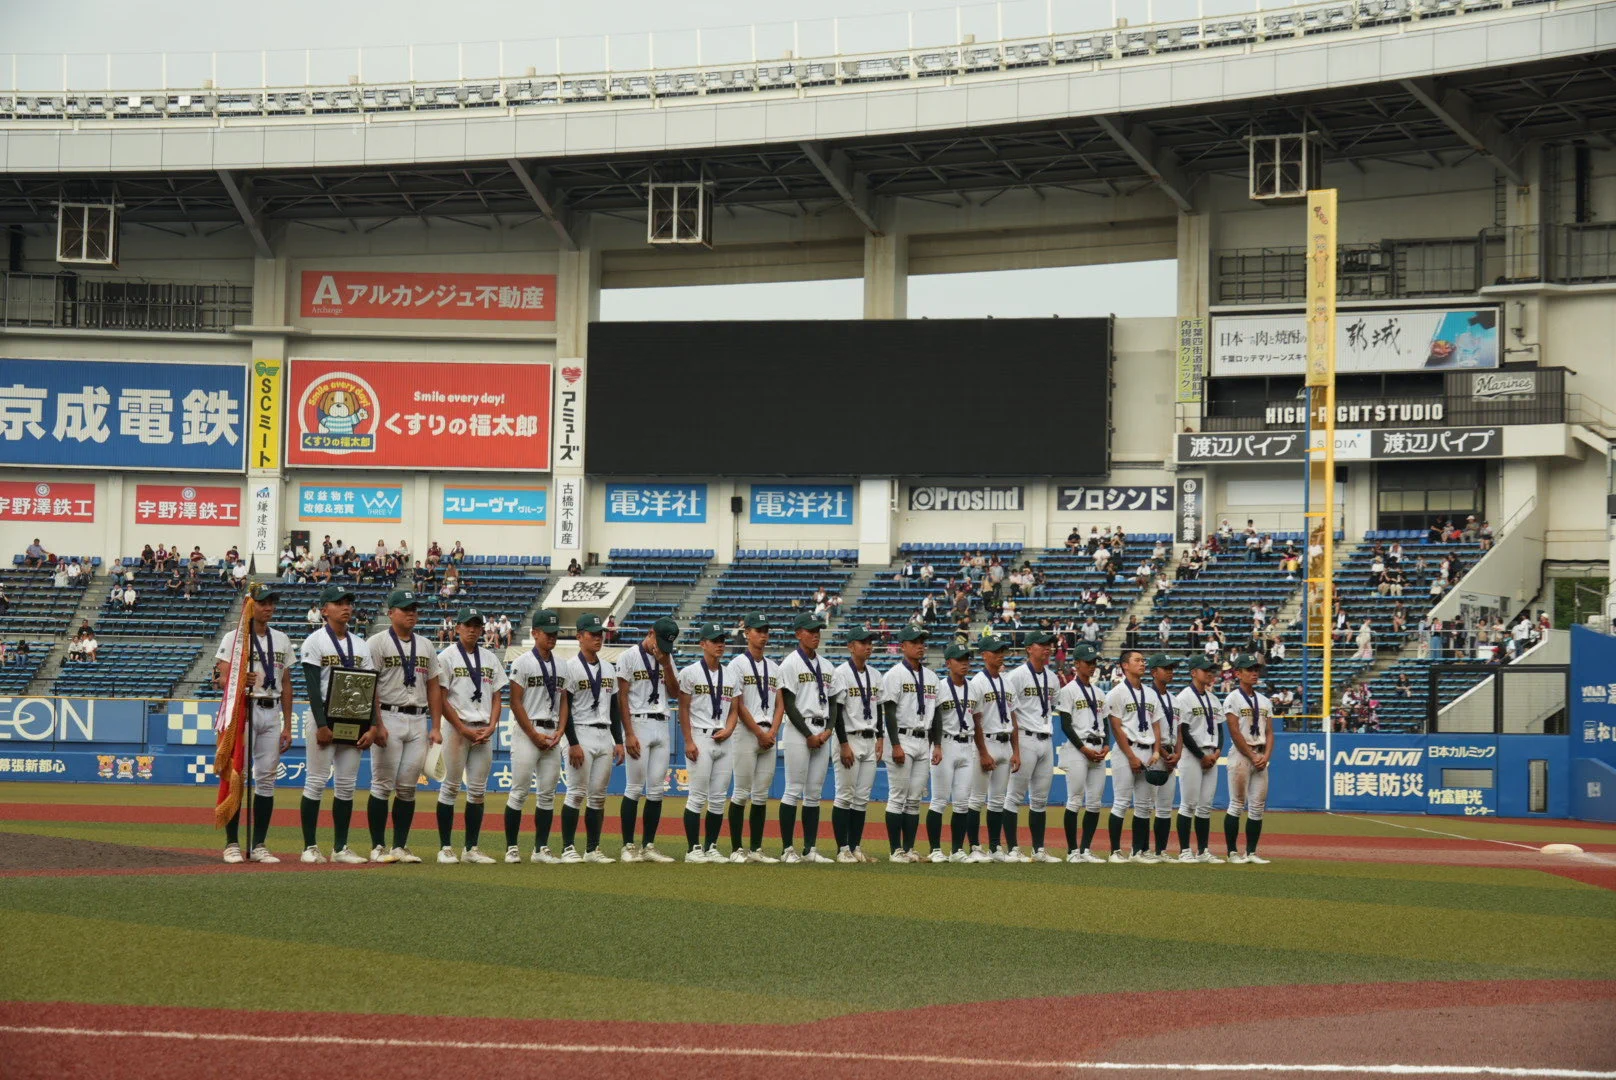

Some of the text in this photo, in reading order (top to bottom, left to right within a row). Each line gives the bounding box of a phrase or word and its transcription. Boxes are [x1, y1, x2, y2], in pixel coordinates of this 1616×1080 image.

[347, 285, 544, 309] アルカンジュ不動産
[1476, 376, 1532, 394] Marines
[414, 390, 505, 407] Smile every day!
[0, 384, 240, 446] 京成電鉄
[259, 378, 272, 467] SCミート
[384, 412, 538, 437] くすりの福太郎
[560, 391, 580, 461] アミューズ
[304, 435, 371, 448] くすりの福太郎
[1190, 434, 1297, 457] 渡辺パイプ
[1383, 430, 1495, 454] 渡辺パイプ
[303, 490, 355, 501] 収益物件
[610, 489, 702, 517] 電洋社
[755, 490, 848, 518] 電洋社
[935, 487, 1019, 510] Prosind
[1064, 487, 1168, 510] プロシンド
[138, 500, 238, 520] 宇野澤鉄工
[561, 483, 574, 545] 古橋不動産
[1333, 747, 1424, 766] NOHMI
[1428, 745, 1496, 758] 日本カルミック
[0, 758, 66, 772] 幕張新都心
[1333, 772, 1424, 797] 能美防災
[1427, 788, 1483, 805] 竹富観光
[1464, 806, 1496, 815] センター
